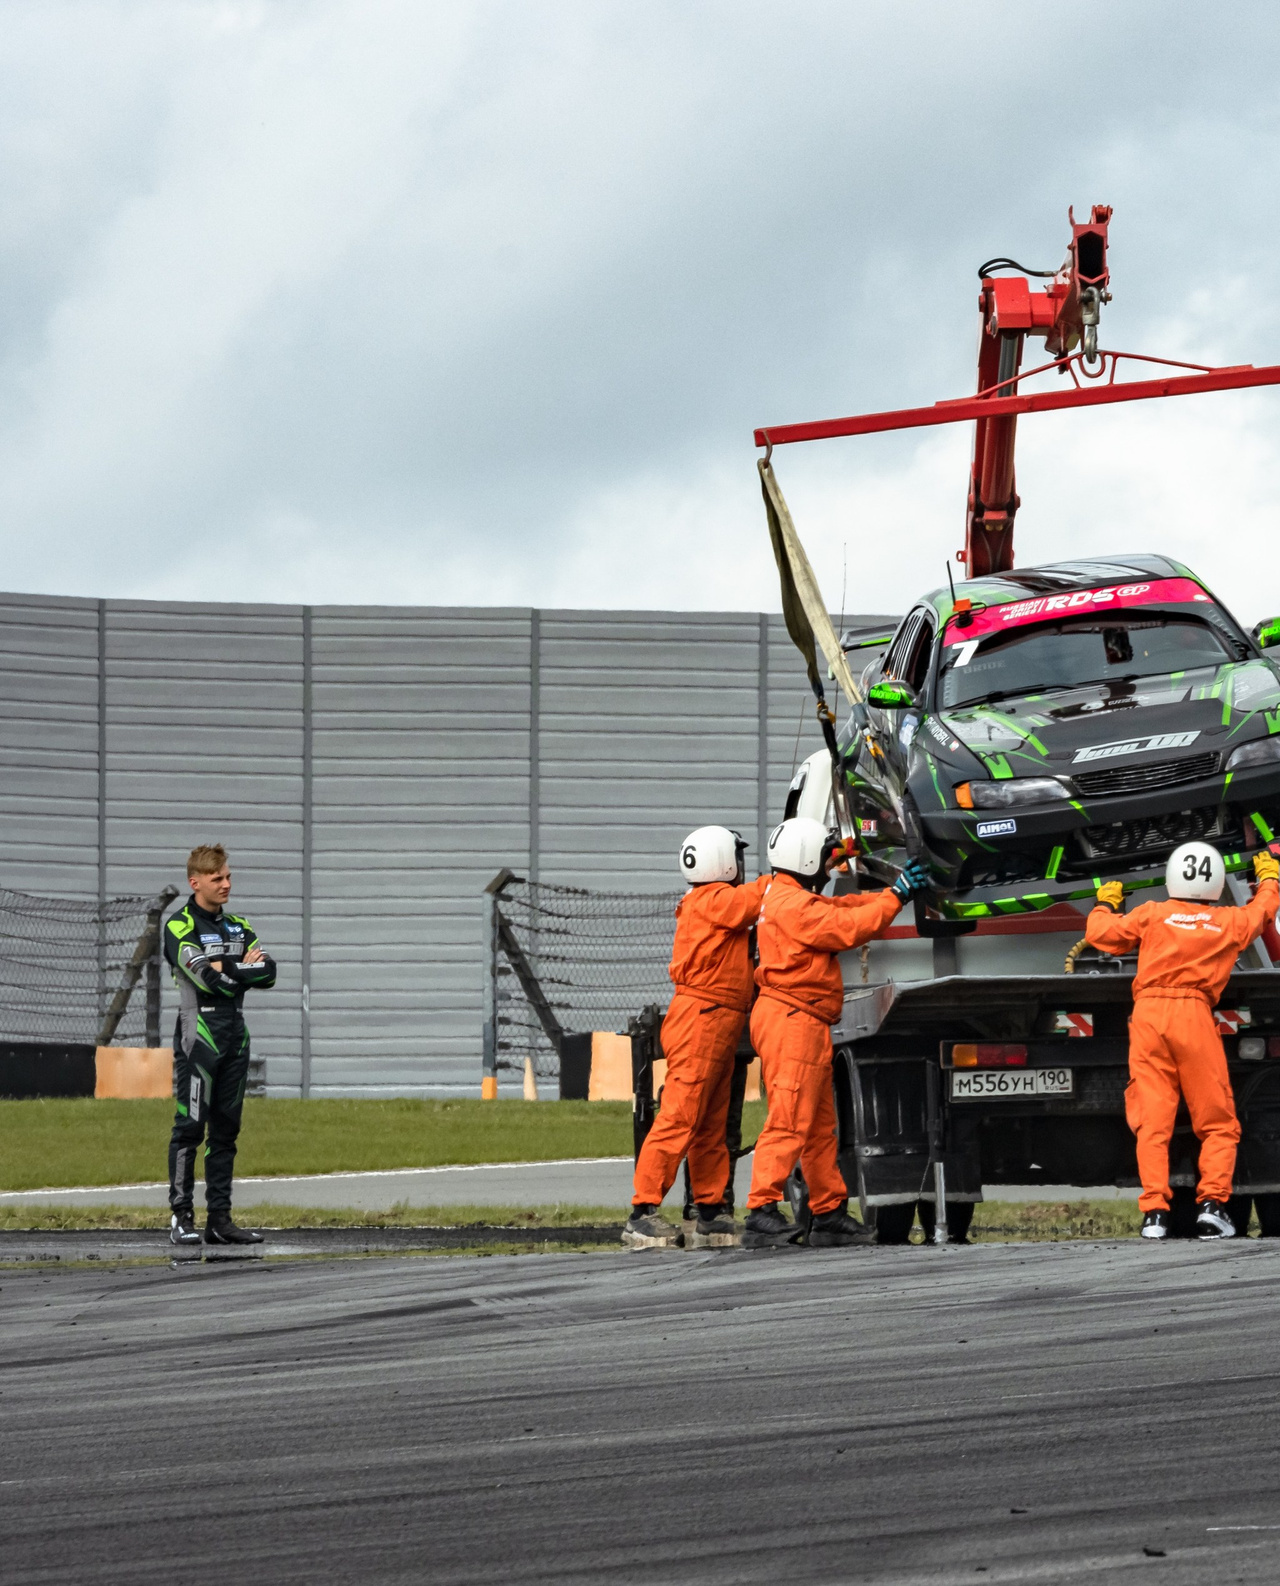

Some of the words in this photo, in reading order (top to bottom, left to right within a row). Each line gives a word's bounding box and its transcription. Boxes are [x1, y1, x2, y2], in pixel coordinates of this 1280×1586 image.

[999, 600, 1041, 613] RUSSIAN
[1045, 588, 1117, 611] RDS
[1117, 585, 1150, 597] GP
[1003, 608, 1037, 620] SERIES
[1011, 604, 1039, 614] DRIFT
[952, 640, 979, 668] 7
[979, 823, 1013, 835] AIMOL
[1183, 854, 1212, 882] 34
[958, 1073, 1034, 1094] М556УН
[1038, 1070, 1067, 1085] 190
